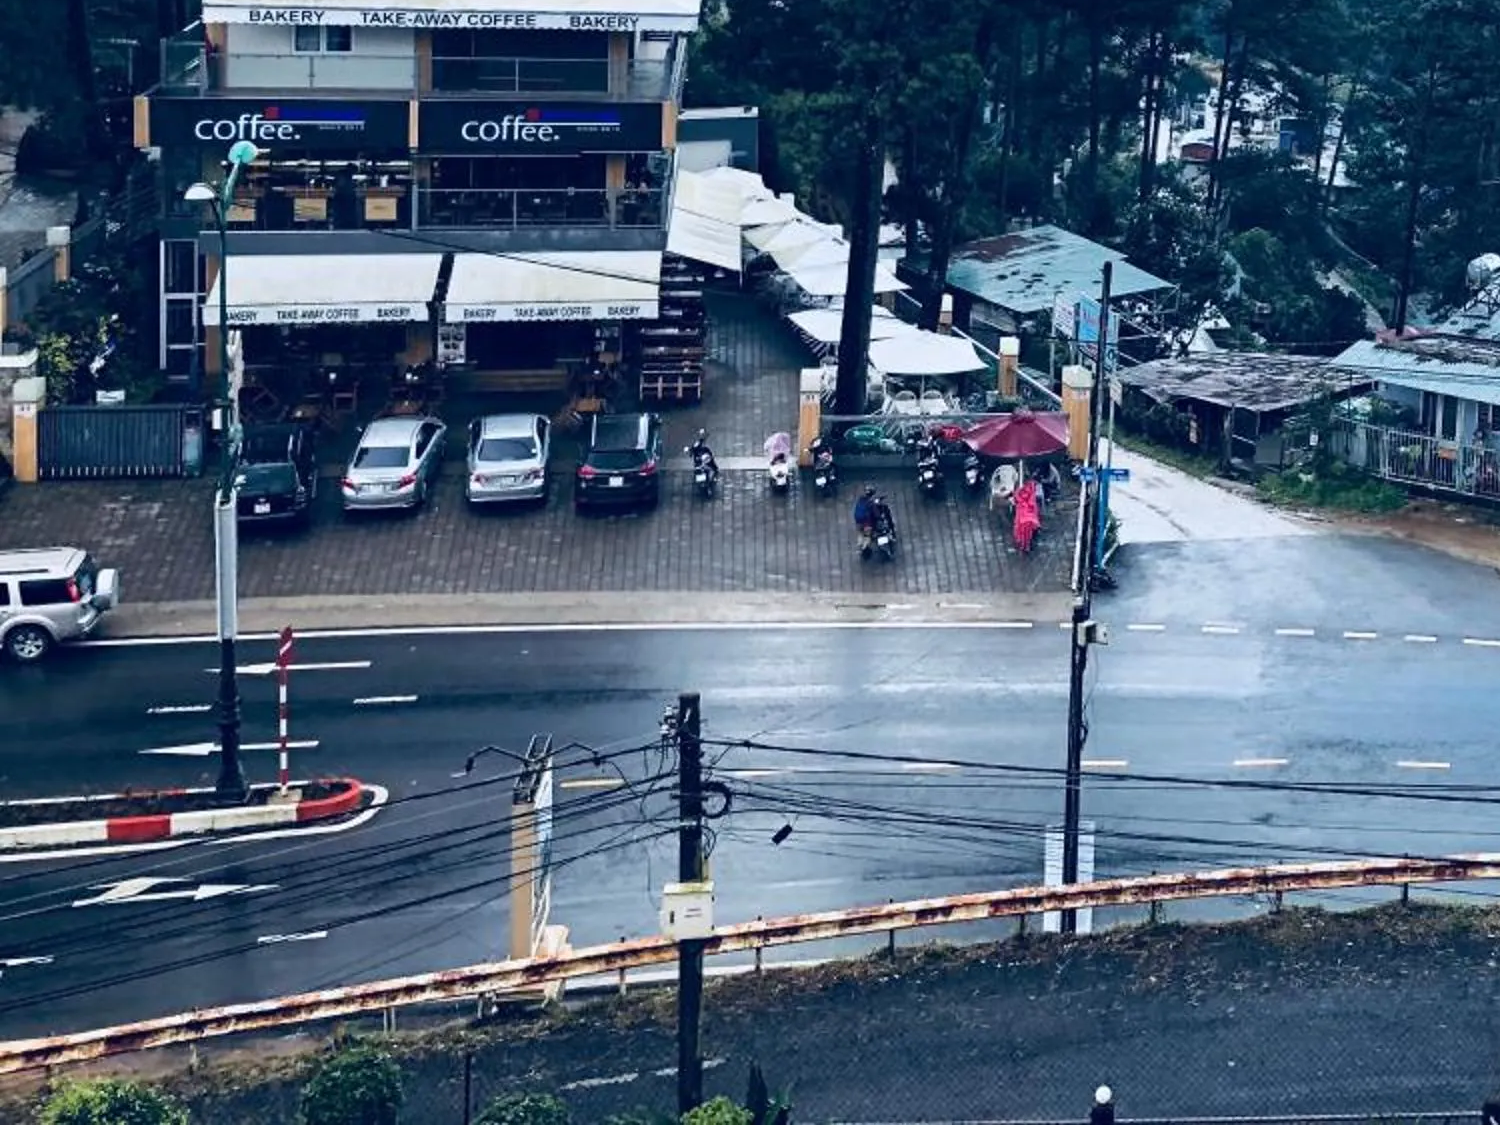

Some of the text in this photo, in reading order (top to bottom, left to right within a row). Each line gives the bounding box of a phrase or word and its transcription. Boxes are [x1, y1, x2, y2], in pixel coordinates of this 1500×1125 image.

[248, 10, 325, 23] BAKERY
[360, 12, 537, 26] TAKE-AWAY COFFEE
[568, 15, 640, 28] BAKERY
[324, 308, 360, 320] COFFEE
[377, 307, 411, 318] BAKERY
[463, 308, 497, 319] BAKERY
[560, 306, 593, 317] COFFEE
[607, 306, 641, 316] BAKERY
